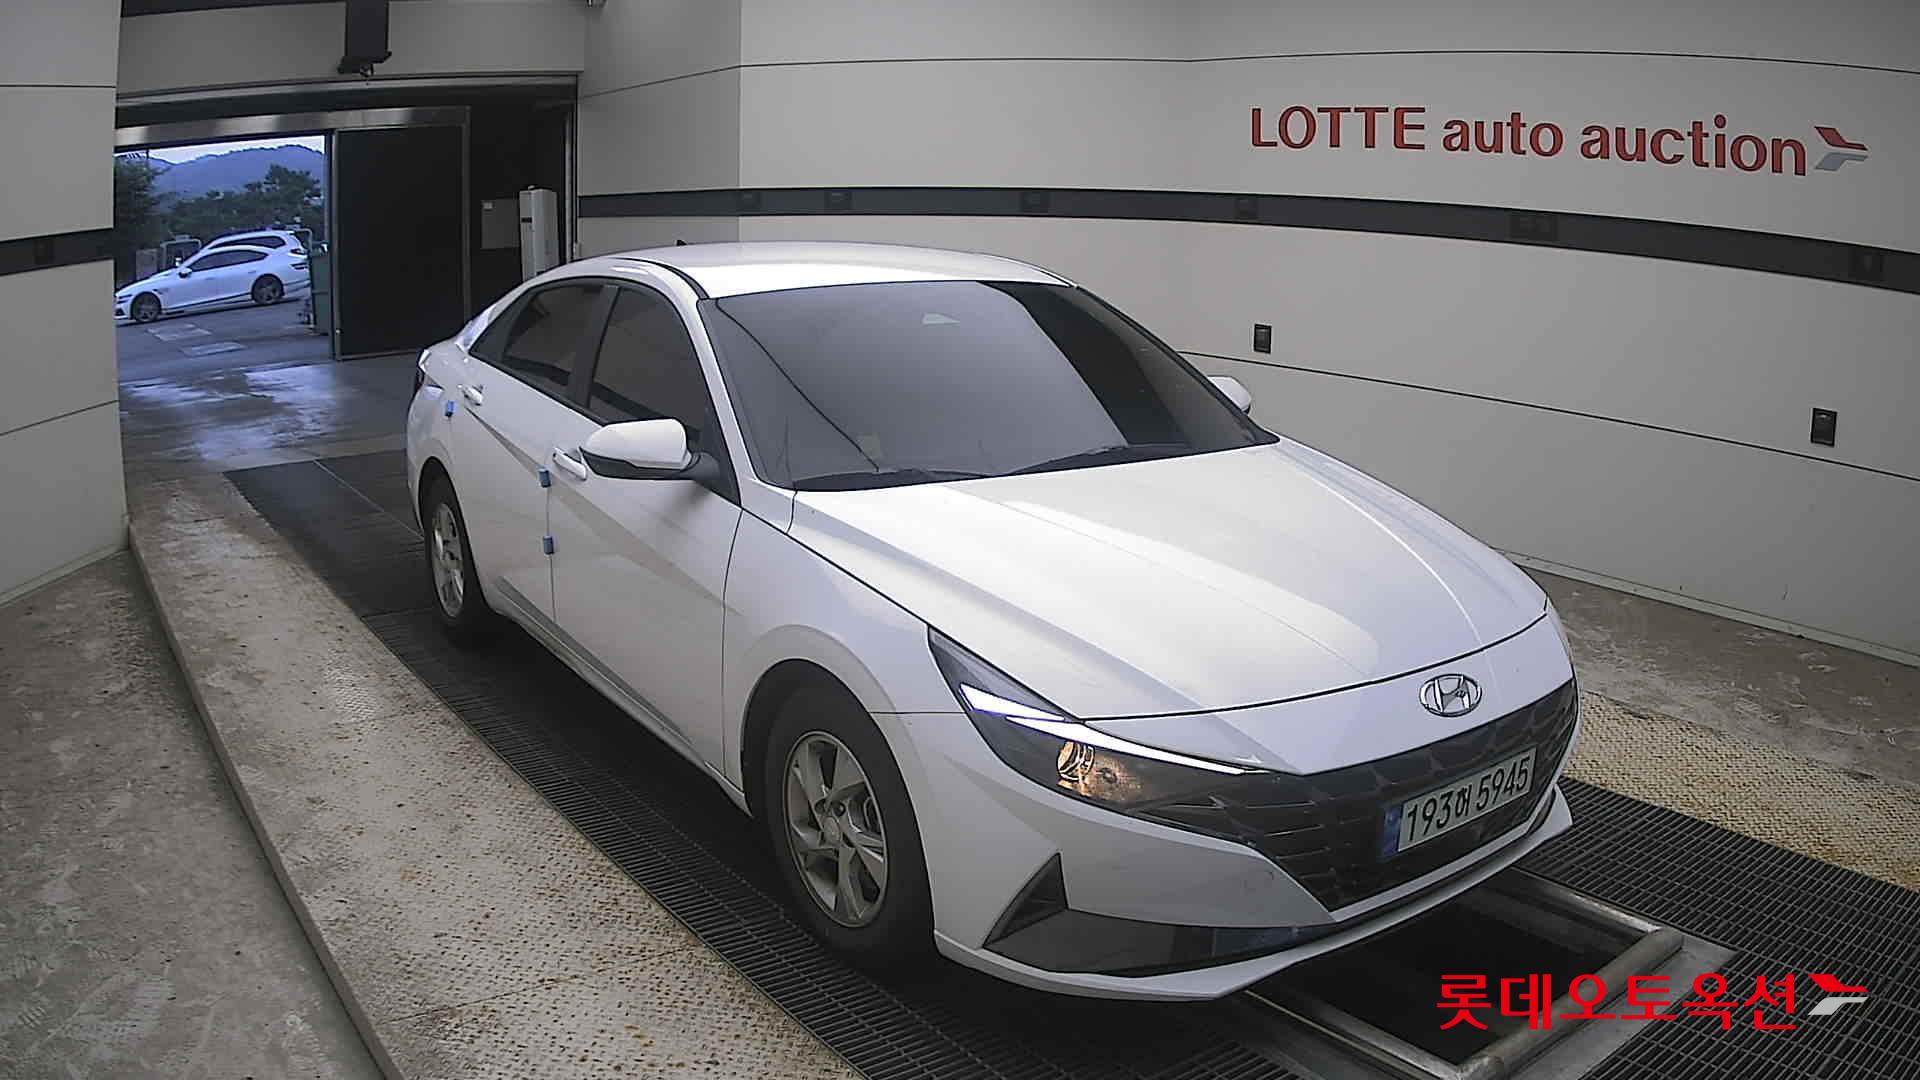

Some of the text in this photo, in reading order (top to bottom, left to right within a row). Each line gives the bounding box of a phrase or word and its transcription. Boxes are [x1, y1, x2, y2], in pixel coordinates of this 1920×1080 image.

[1251, 106, 1807, 177] LOTTE auto auction
[1476, 755, 1531, 812] 5945
